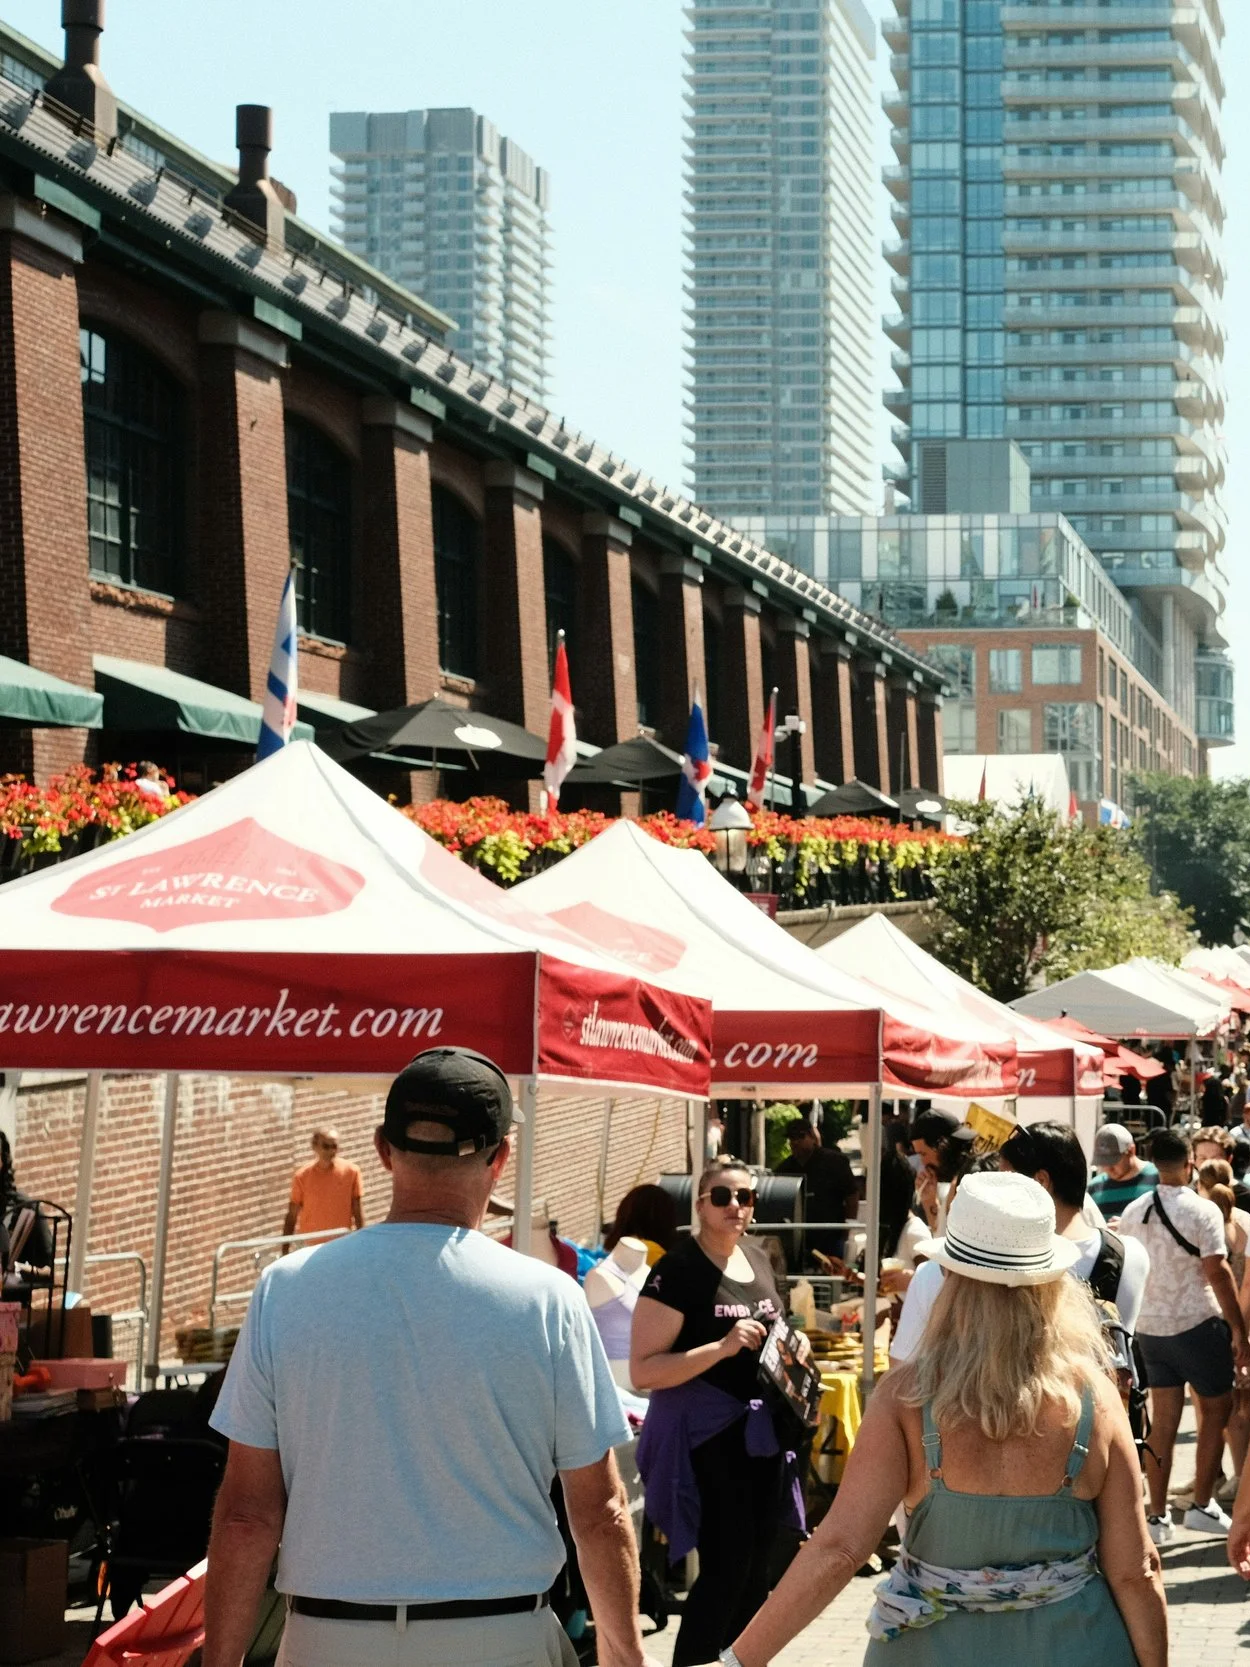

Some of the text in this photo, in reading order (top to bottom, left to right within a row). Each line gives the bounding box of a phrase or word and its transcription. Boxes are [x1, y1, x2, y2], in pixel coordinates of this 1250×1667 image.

[127, 871, 320, 904] LAWRENCE
[139, 894, 241, 909] MARKET
[0, 988, 444, 1039] awrencemarket.com
[714, 1298, 775, 1318] EMBCE
